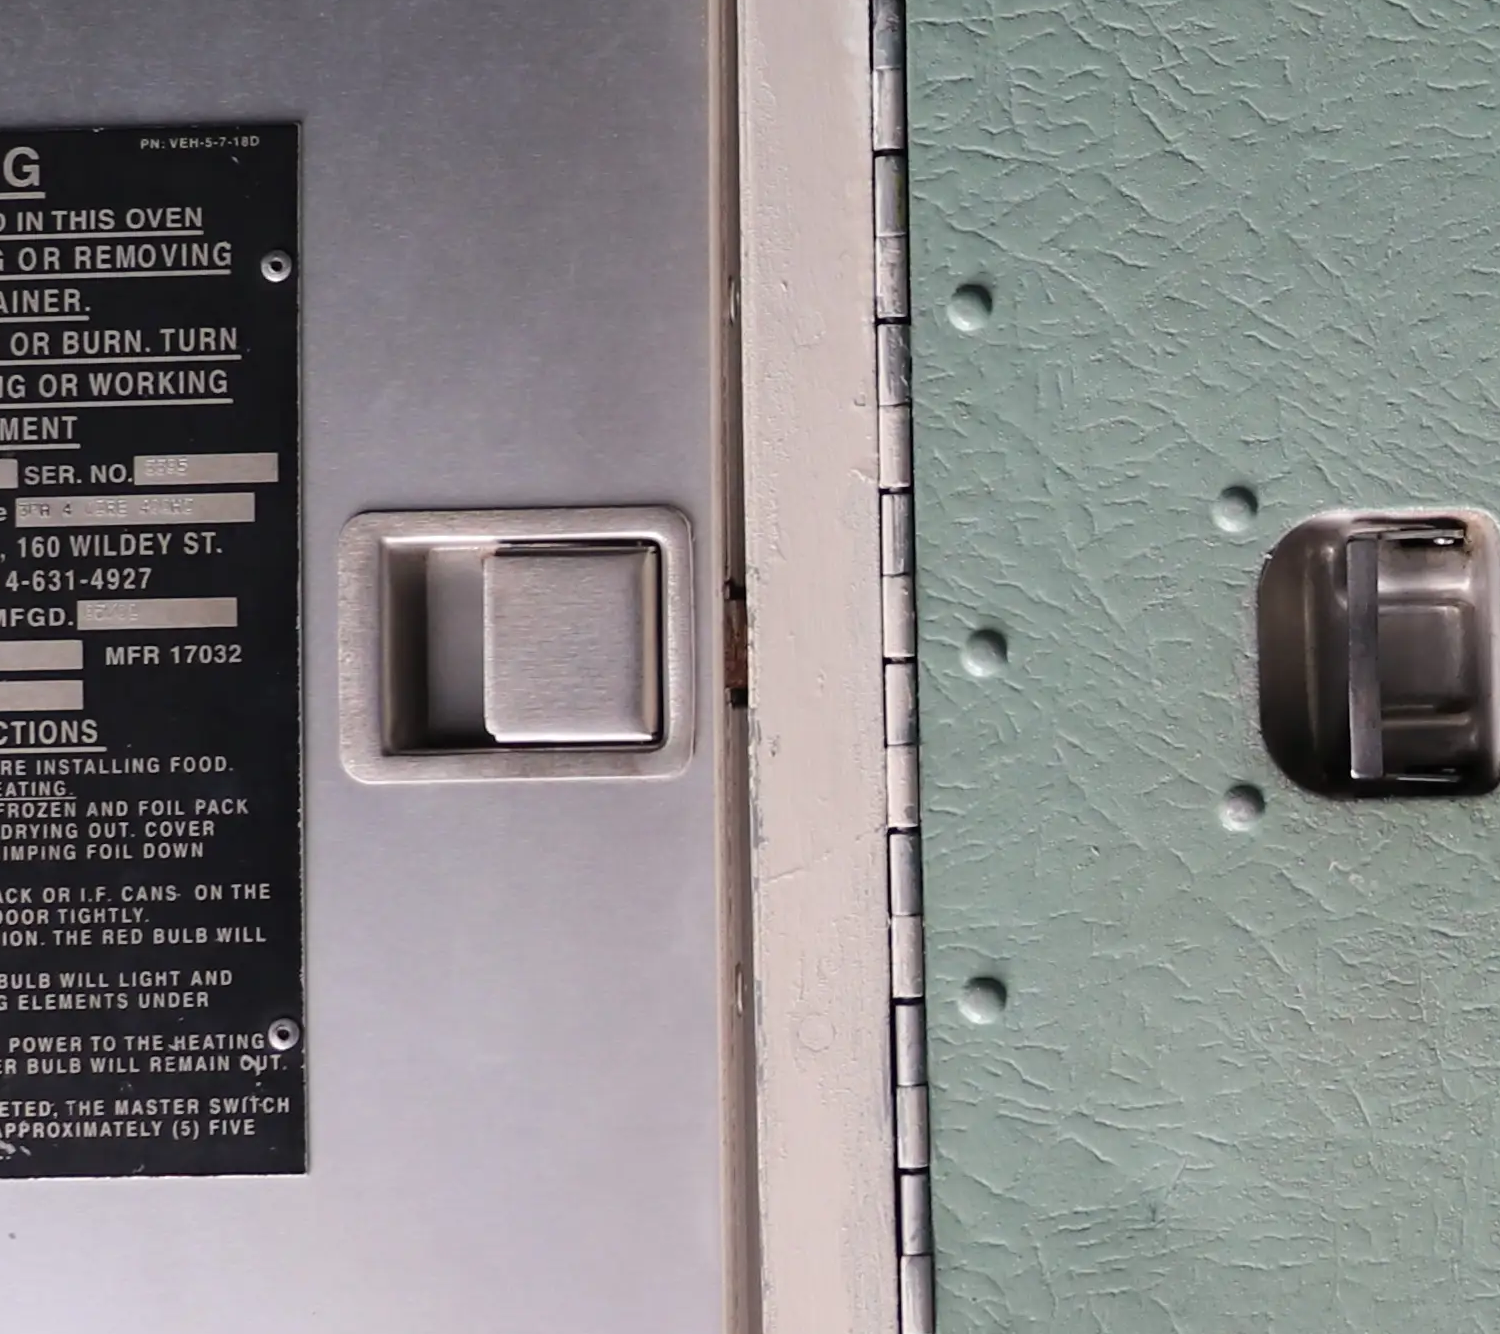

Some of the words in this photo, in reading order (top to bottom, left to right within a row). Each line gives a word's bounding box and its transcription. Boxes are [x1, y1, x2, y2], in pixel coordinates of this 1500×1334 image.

[139, 137, 166, 151] PN:
[16, 210, 44, 233] IN
[49, 207, 116, 232] THIS
[125, 205, 203, 230] OVEN
[17, 245, 61, 273] OR
[73, 240, 233, 271] REMOVING
[9, 330, 51, 358] OR
[61, 328, 152, 356] BURN.
[158, 326, 238, 353] TURN
[37, 372, 79, 399] OR
[87, 368, 228, 397] WORKING
[23, 464, 83, 486] SER.
[89, 462, 134, 485] NO.
[16, 534, 61, 559] 160
[68, 531, 173, 558] WILDEY
[182, 530, 223, 556] ST.
[104, 644, 161, 667] MFR
[169, 643, 243, 665] 17032
[35, 756, 161, 777] INSTALLING
[169, 755, 234, 774] FOOD.
[85, 799, 129, 818] AND
[137, 799, 186, 817] FOIL
[194, 797, 249, 816] PACK
[56, 906, 150, 925] TIGHTLY.
[51, 928, 93, 947] THE
[101, 927, 144, 946] RED
[152, 926, 209, 945] BULB
[215, 925, 267, 944] WILL
[58, 971, 110, 989] WILL
[118, 969, 181, 988] LIGHT
[190, 969, 233, 987] AND
